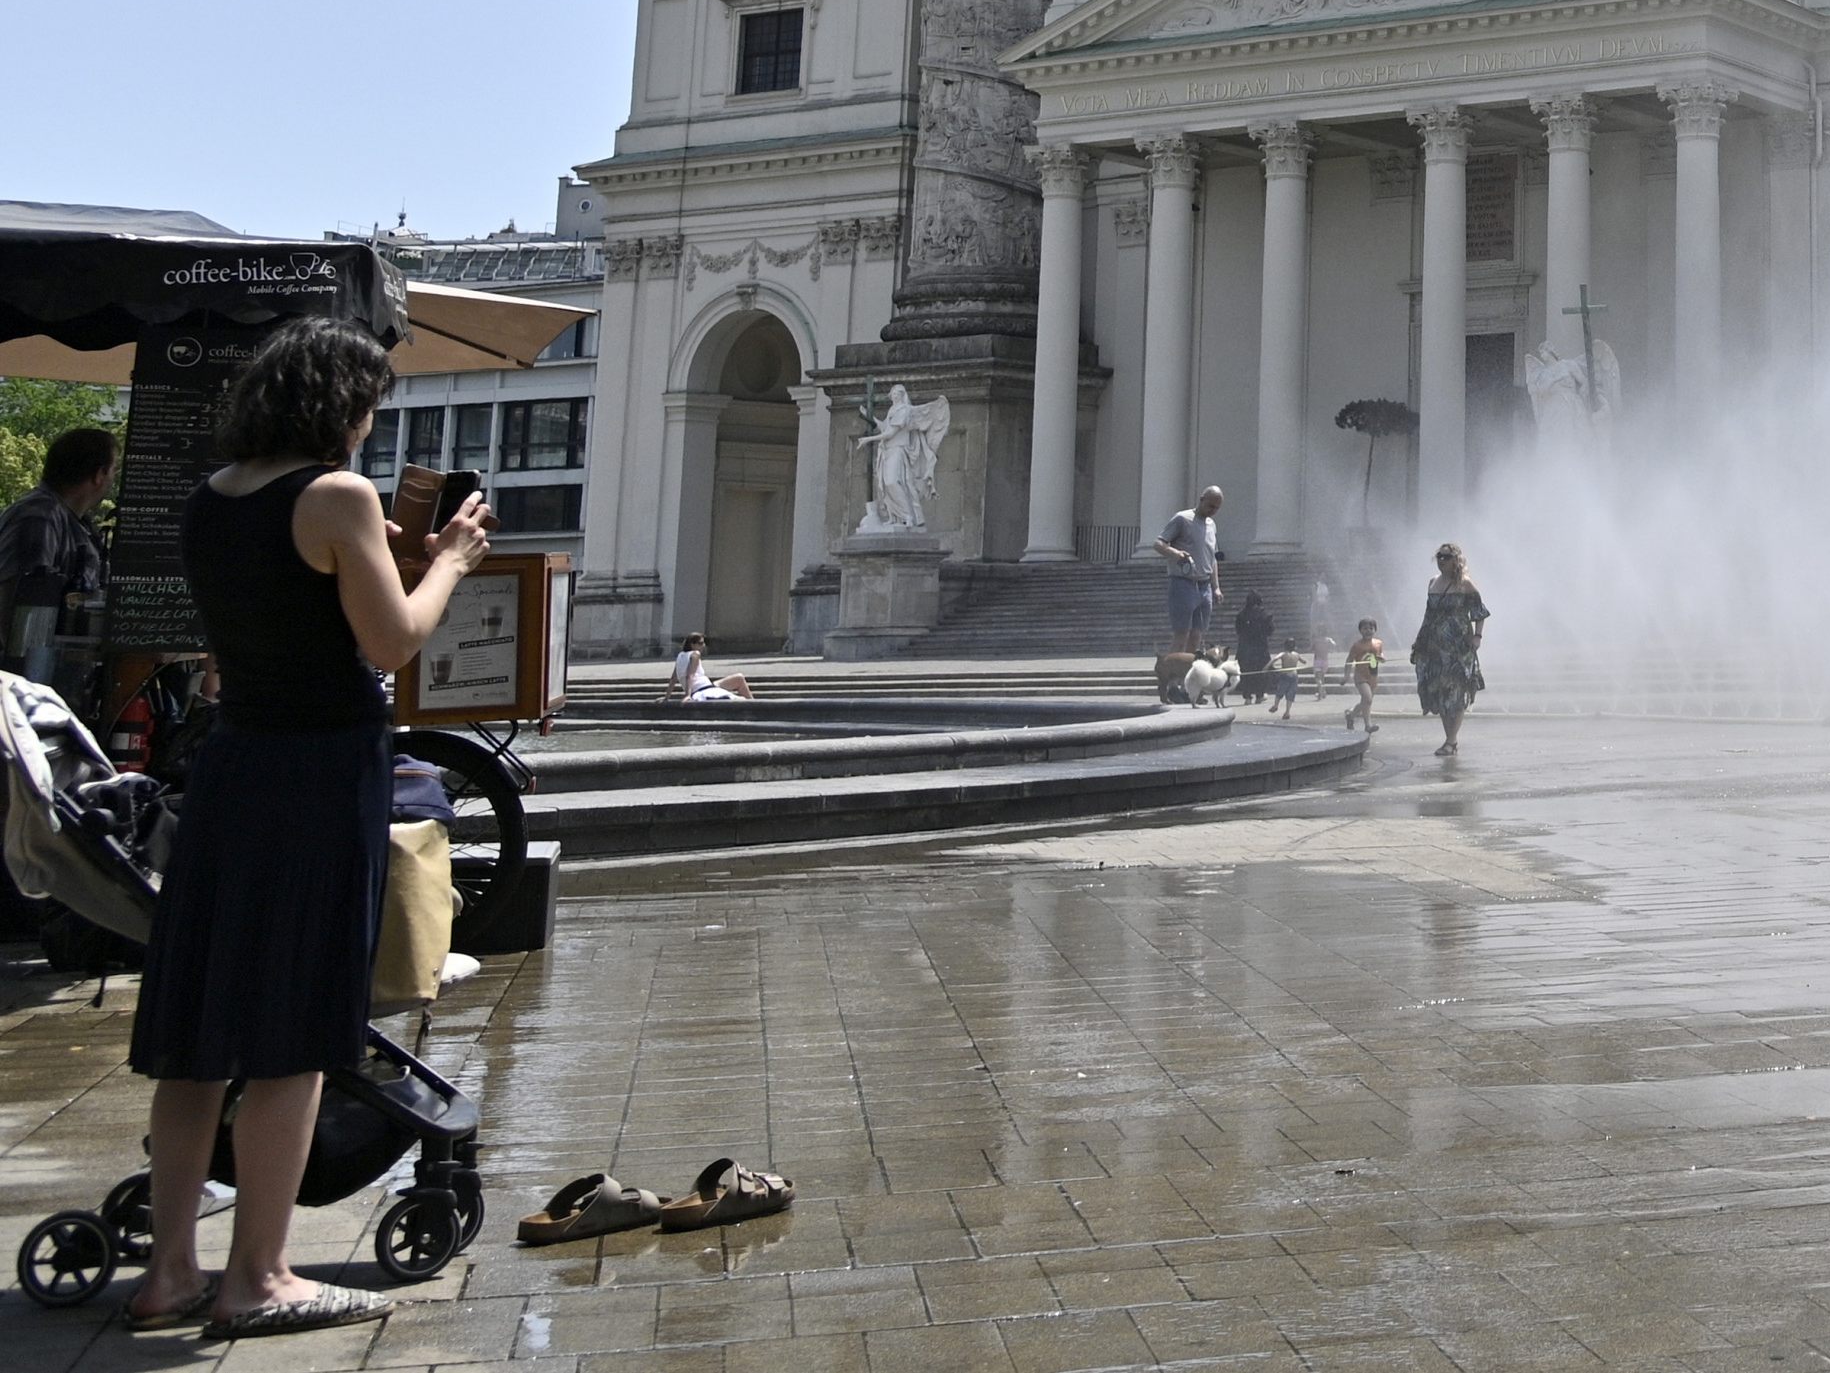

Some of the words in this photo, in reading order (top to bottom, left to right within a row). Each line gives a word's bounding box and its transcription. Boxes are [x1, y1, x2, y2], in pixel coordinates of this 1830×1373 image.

[1060, 95, 1111, 115] VOTA
[1125, 87, 1171, 108] MEA
[1186, 77, 1271, 102] REDDAM
[1286, 71, 1305, 92] IN
[1457, 43, 1583, 73] TIMENTIVM
[248, 285, 274, 294] Mobile
[276, 284, 299, 295] Coffee
[301, 284, 338, 295] Company
[126, 582, 191, 595] MILCHKA
[120, 595, 166, 605] VANILLE
